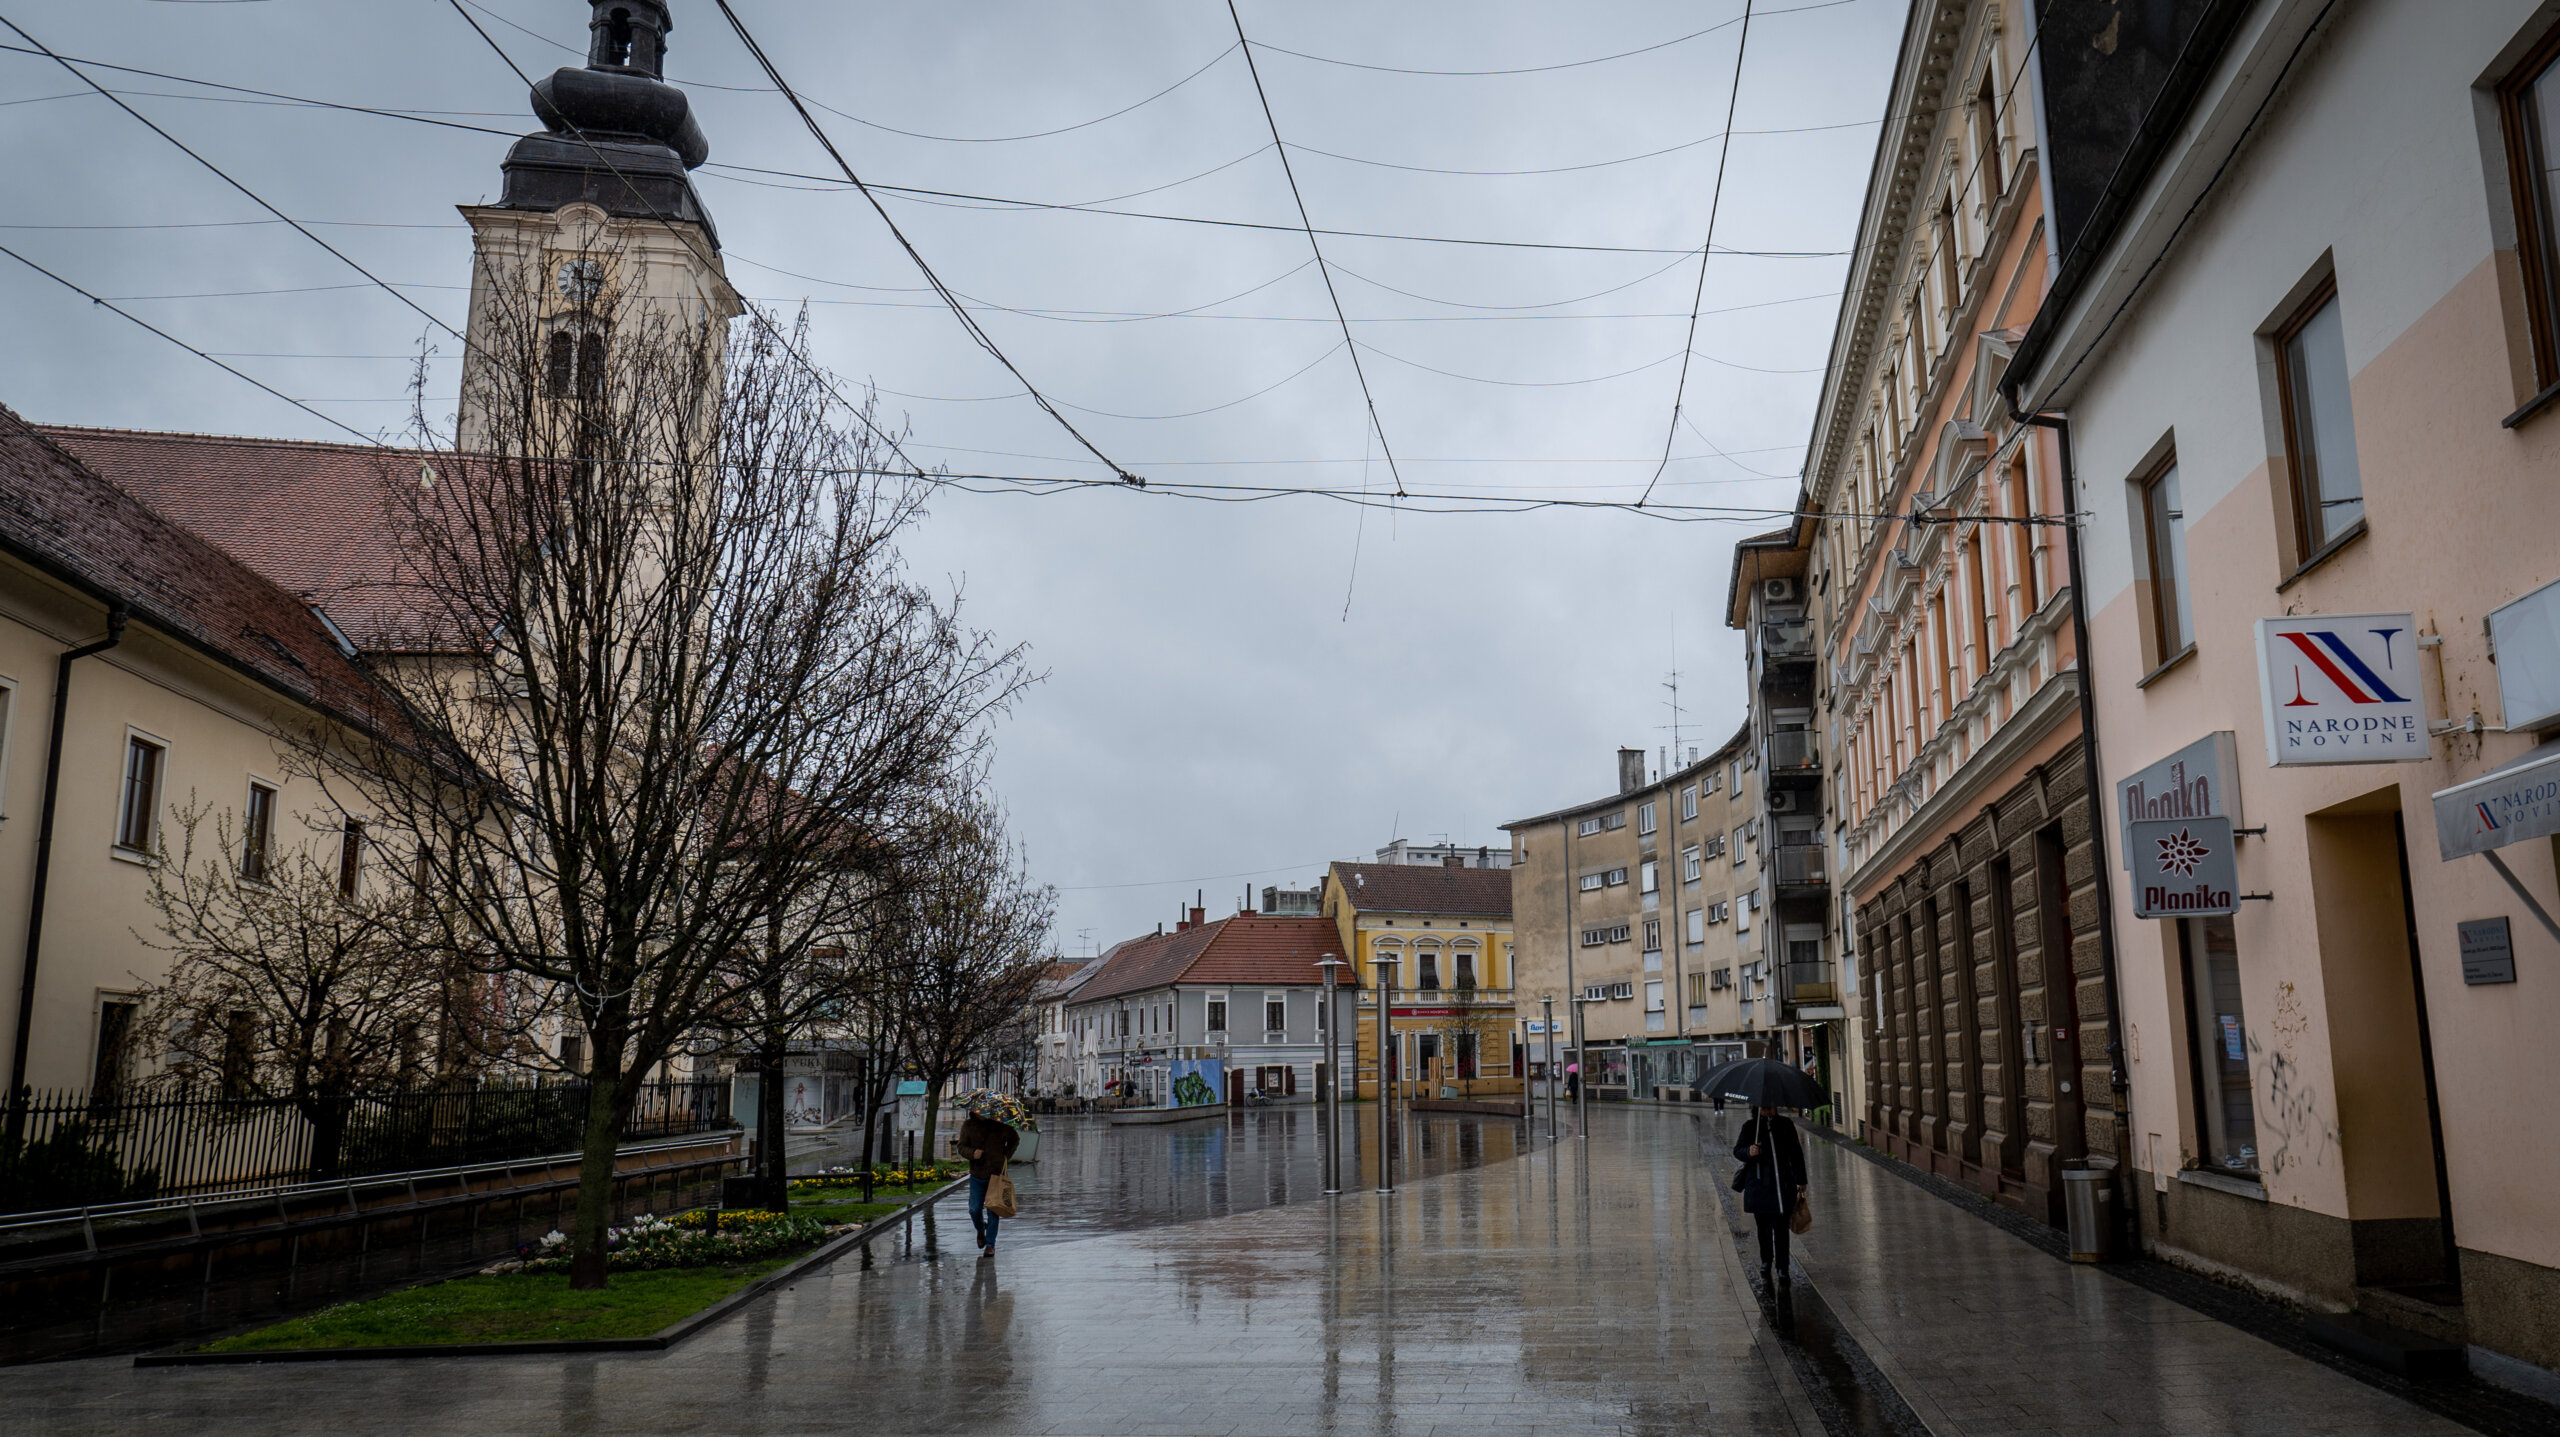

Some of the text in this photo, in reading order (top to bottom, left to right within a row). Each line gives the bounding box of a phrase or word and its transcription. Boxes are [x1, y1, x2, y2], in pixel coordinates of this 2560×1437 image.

[2287, 715, 2416, 734] NARODNE
[2288, 731, 2418, 747] NOVINE
[2502, 778, 2560, 811] NAROD
[2503, 799, 2560, 826] NOVI
[2145, 884, 2231, 911] Planika
